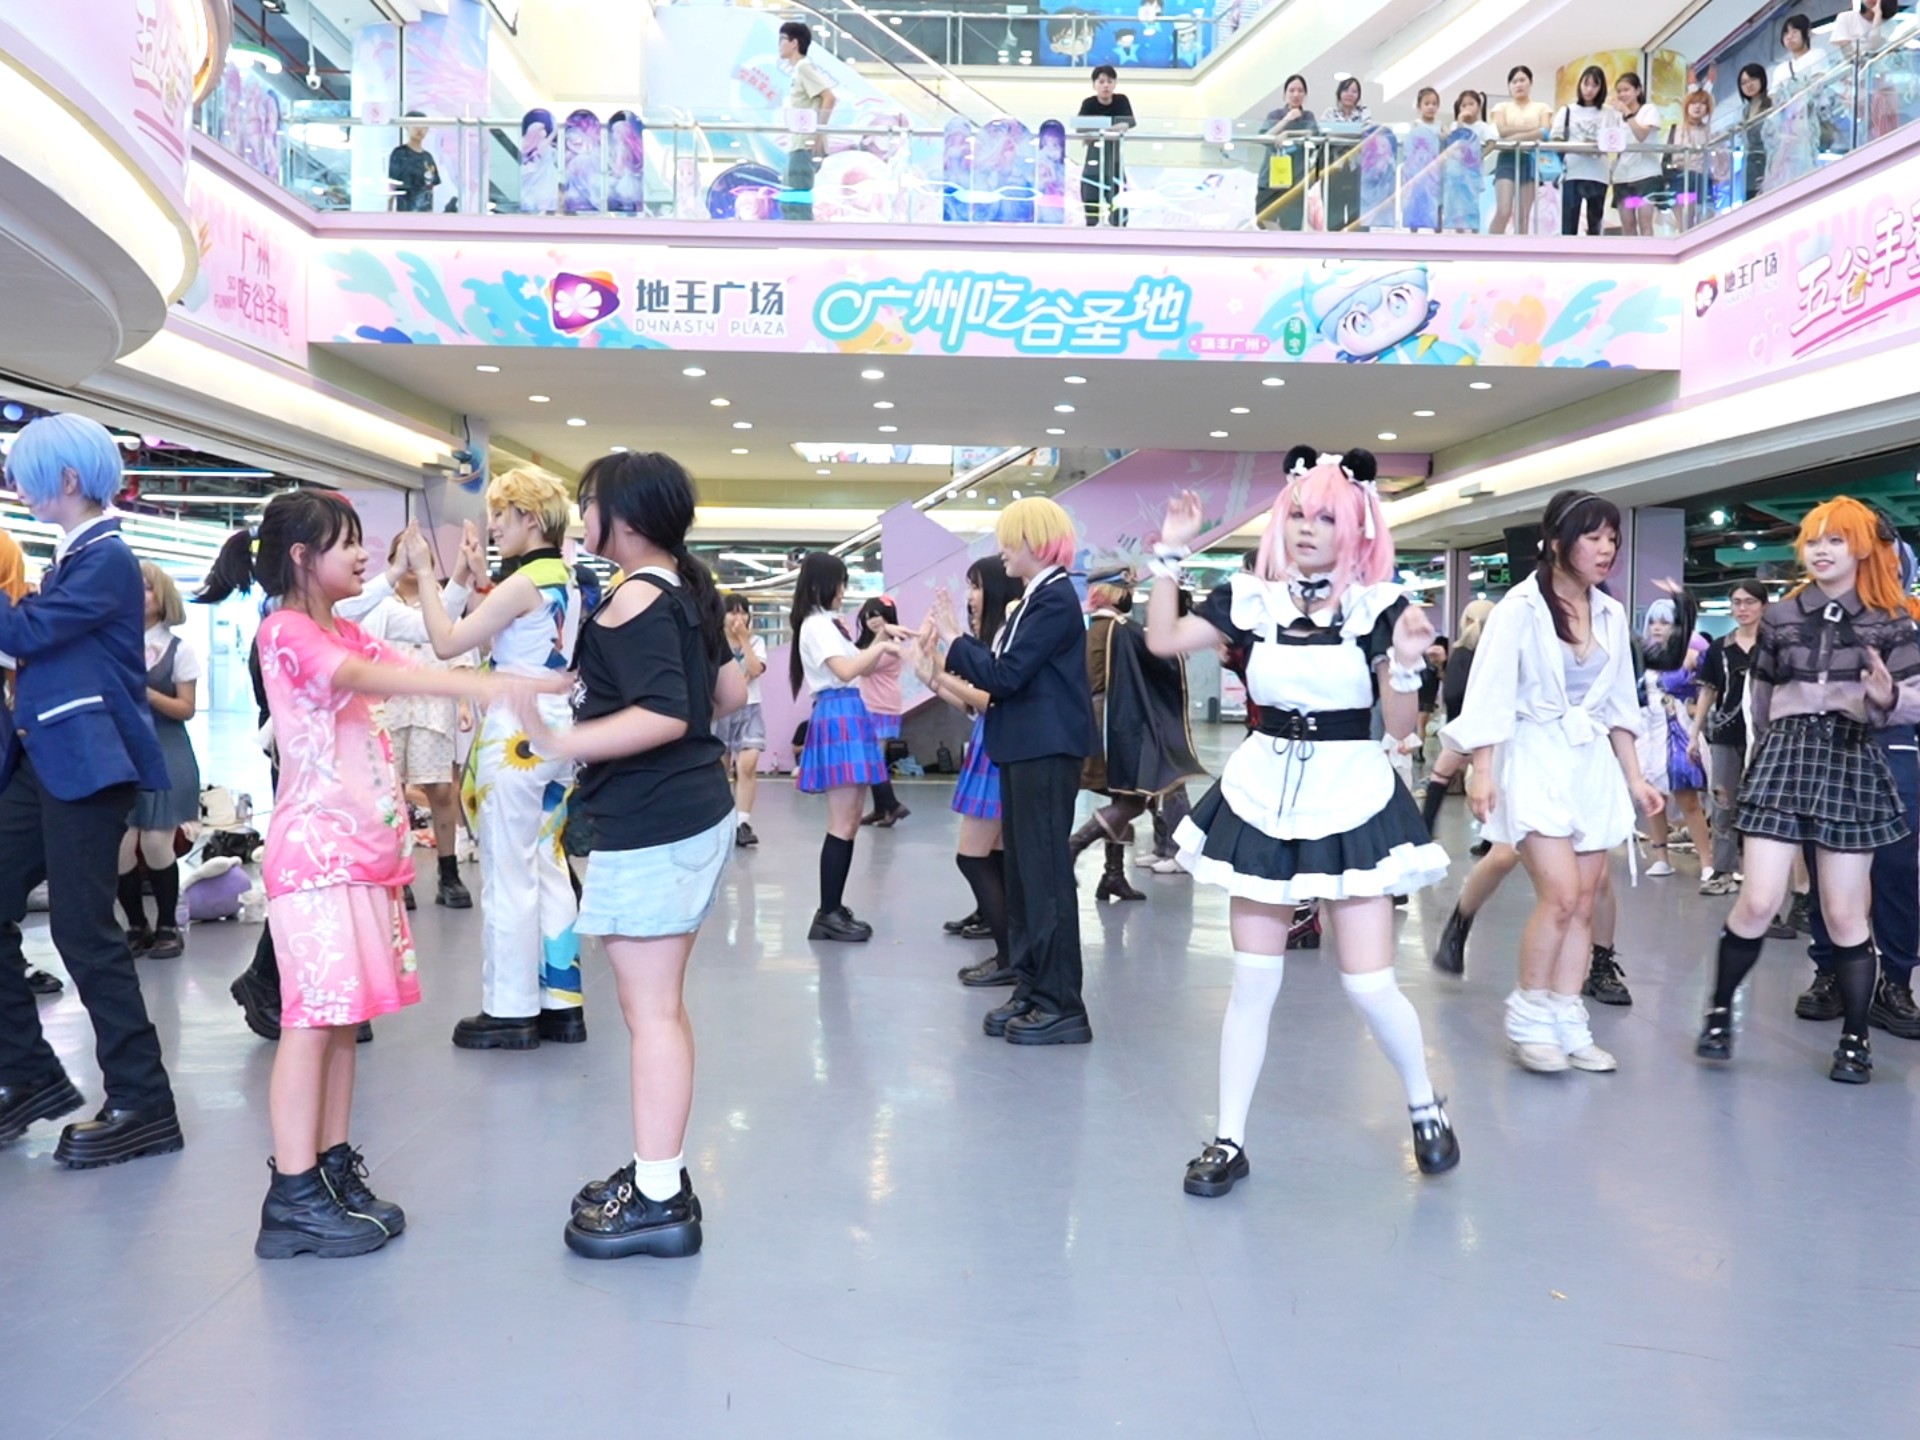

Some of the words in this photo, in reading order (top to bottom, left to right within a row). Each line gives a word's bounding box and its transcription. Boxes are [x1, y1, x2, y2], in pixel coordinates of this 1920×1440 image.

[241, 229, 271, 281] 广州
[1723, 251, 1778, 294] 地王广场
[237, 276, 291, 337] 吃谷圣地
[635, 278, 785, 316] 地王广场
[819, 275, 1186, 347] 广州吃谷圣地
[635, 317, 716, 335] DYNASTY
[730, 319, 786, 336] PLAZA
